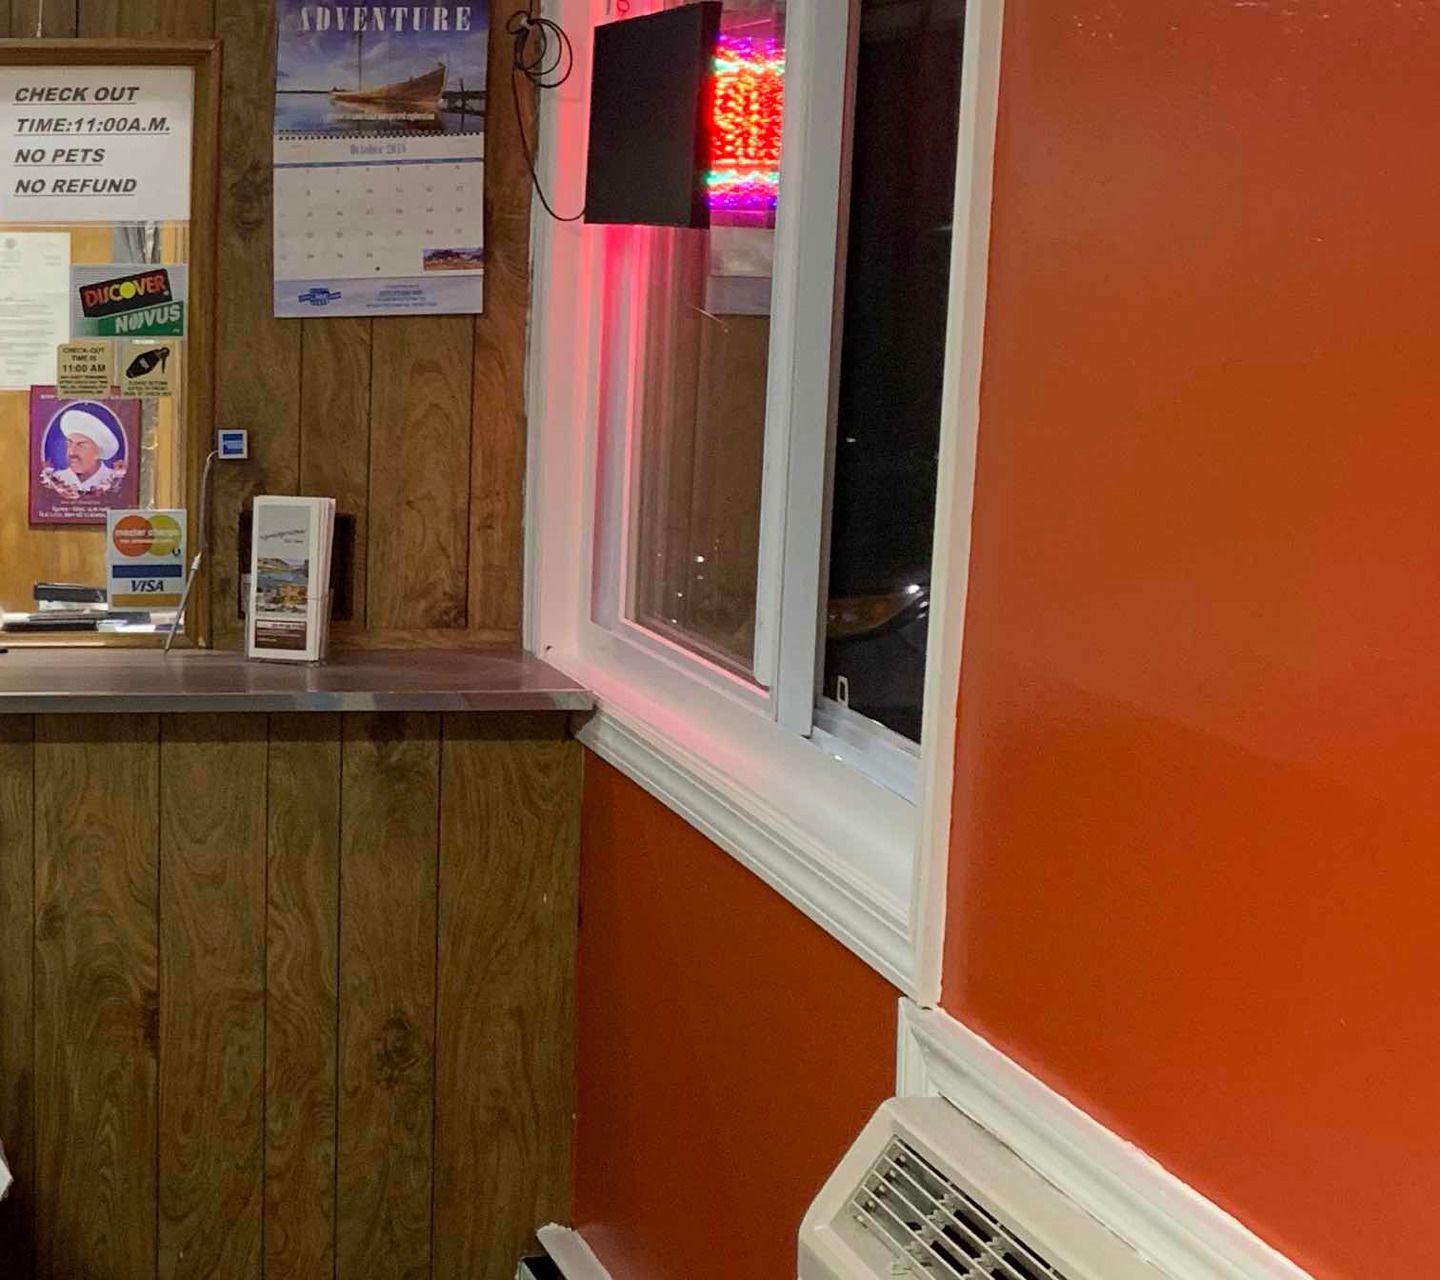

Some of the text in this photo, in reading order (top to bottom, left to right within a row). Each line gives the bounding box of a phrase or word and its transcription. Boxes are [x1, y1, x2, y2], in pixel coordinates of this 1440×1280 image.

[298, 6, 472, 32] ADVENTURE
[14, 86, 140, 102] CHECK OUT
[17, 117, 171, 133] TIME:11:00A.M.
[14, 148, 106, 163] NO PETS
[14, 178, 137, 194] NO REFUND
[63, 364, 106, 372] 11:00 AM
[115, 529, 146, 537] master
[131, 580, 165, 592] VISA
